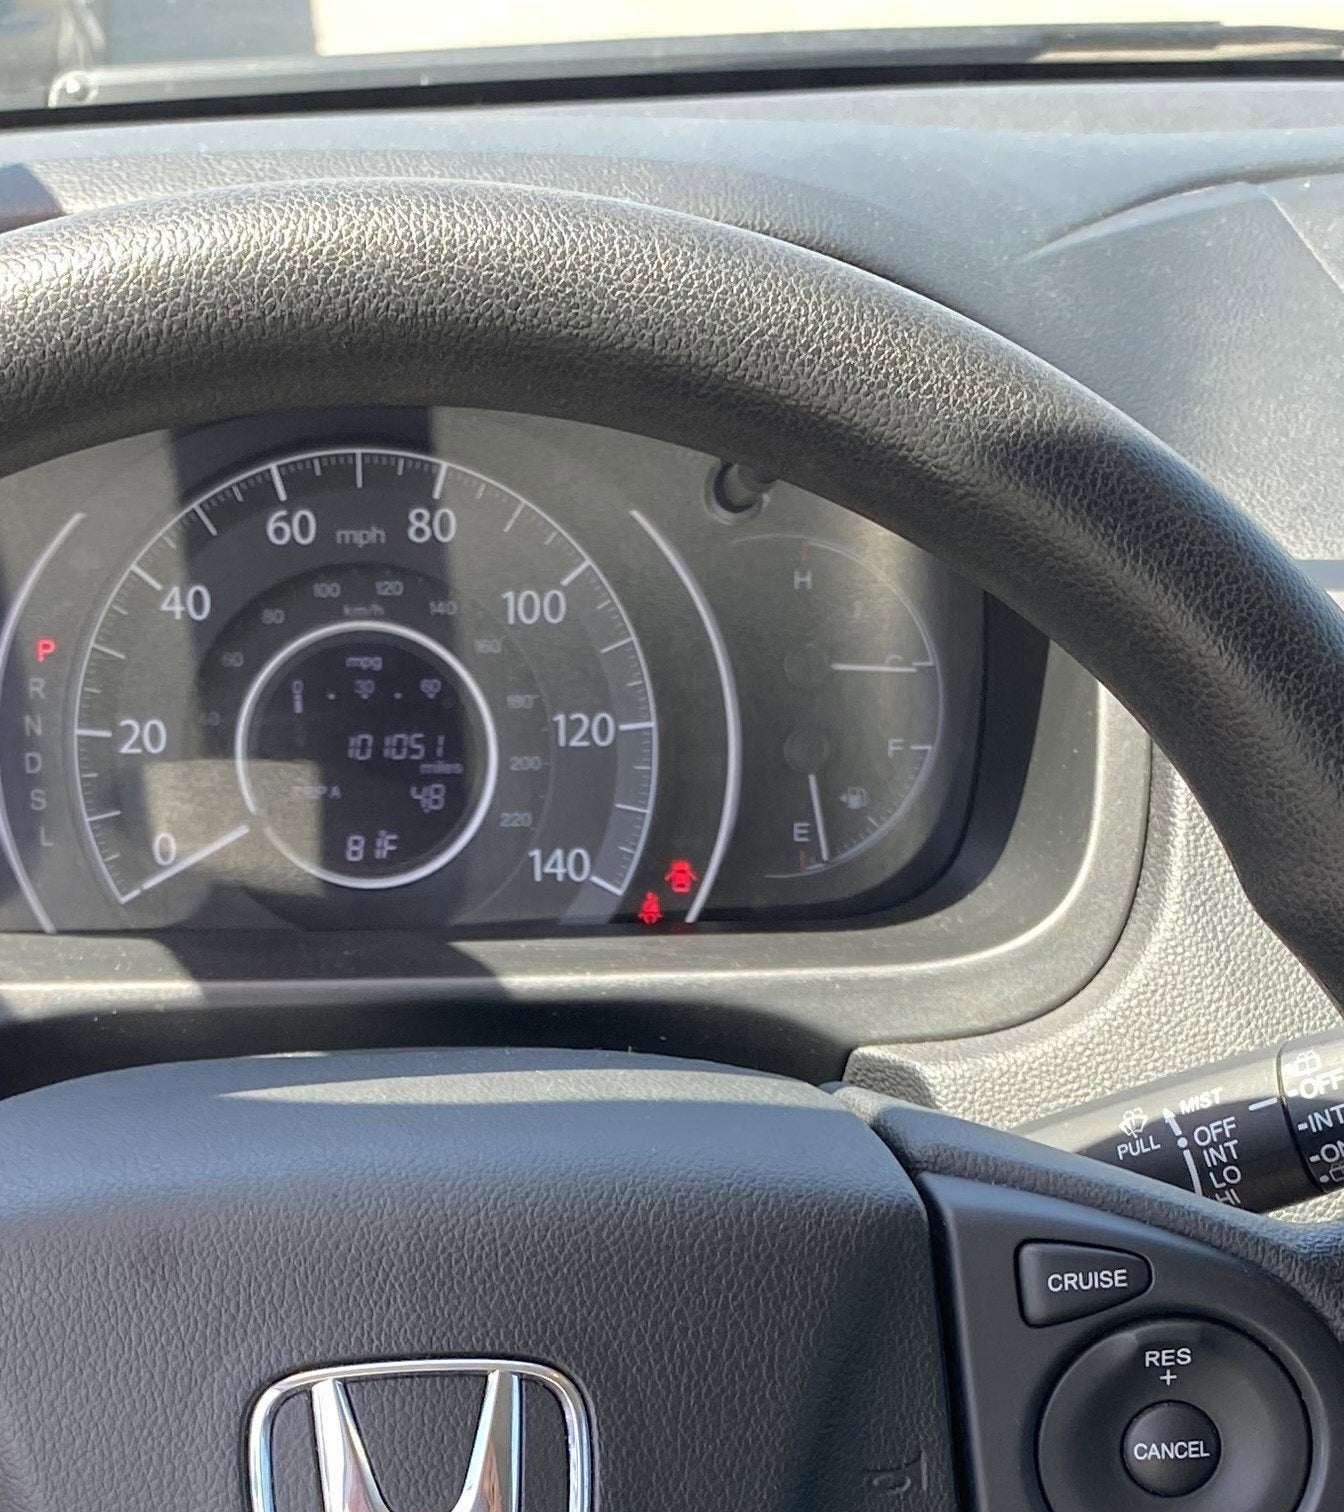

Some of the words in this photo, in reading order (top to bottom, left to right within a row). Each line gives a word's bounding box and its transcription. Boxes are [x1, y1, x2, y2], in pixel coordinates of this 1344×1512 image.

[266, 510, 317, 546] 60
[336, 524, 386, 549] mph
[407, 508, 456, 544] 80
[794, 571, 812, 589] H
[160, 585, 211, 621] 40
[502, 590, 567, 625] 100
[35, 638, 56, 662] P
[346, 656, 383, 672] mpg
[28, 678, 46, 700] R
[25, 715, 42, 737] N
[119, 720, 166, 755] 20
[552, 712, 616, 748] 120
[888, 739, 904, 757] F
[26, 752, 42, 774] D
[30, 789, 47, 811] S
[40, 826, 54, 848] L
[793, 822, 810, 843] E
[152, 833, 176, 867] 0
[528, 848, 591, 883] 140
[1299, 1067, 1344, 1099] OFF
[1179, 1086, 1224, 1115] MIST
[1307, 1103, 1344, 1133] INT
[1193, 1116, 1236, 1147] OFF
[1116, 1135, 1161, 1160] PULL
[1202, 1139, 1238, 1168] INT
[1209, 1165, 1242, 1189] LO
[1047, 1268, 1128, 1292] CRUISE
[1145, 1347, 1192, 1367] RES
[1133, 1440, 1210, 1461] CANCEL
